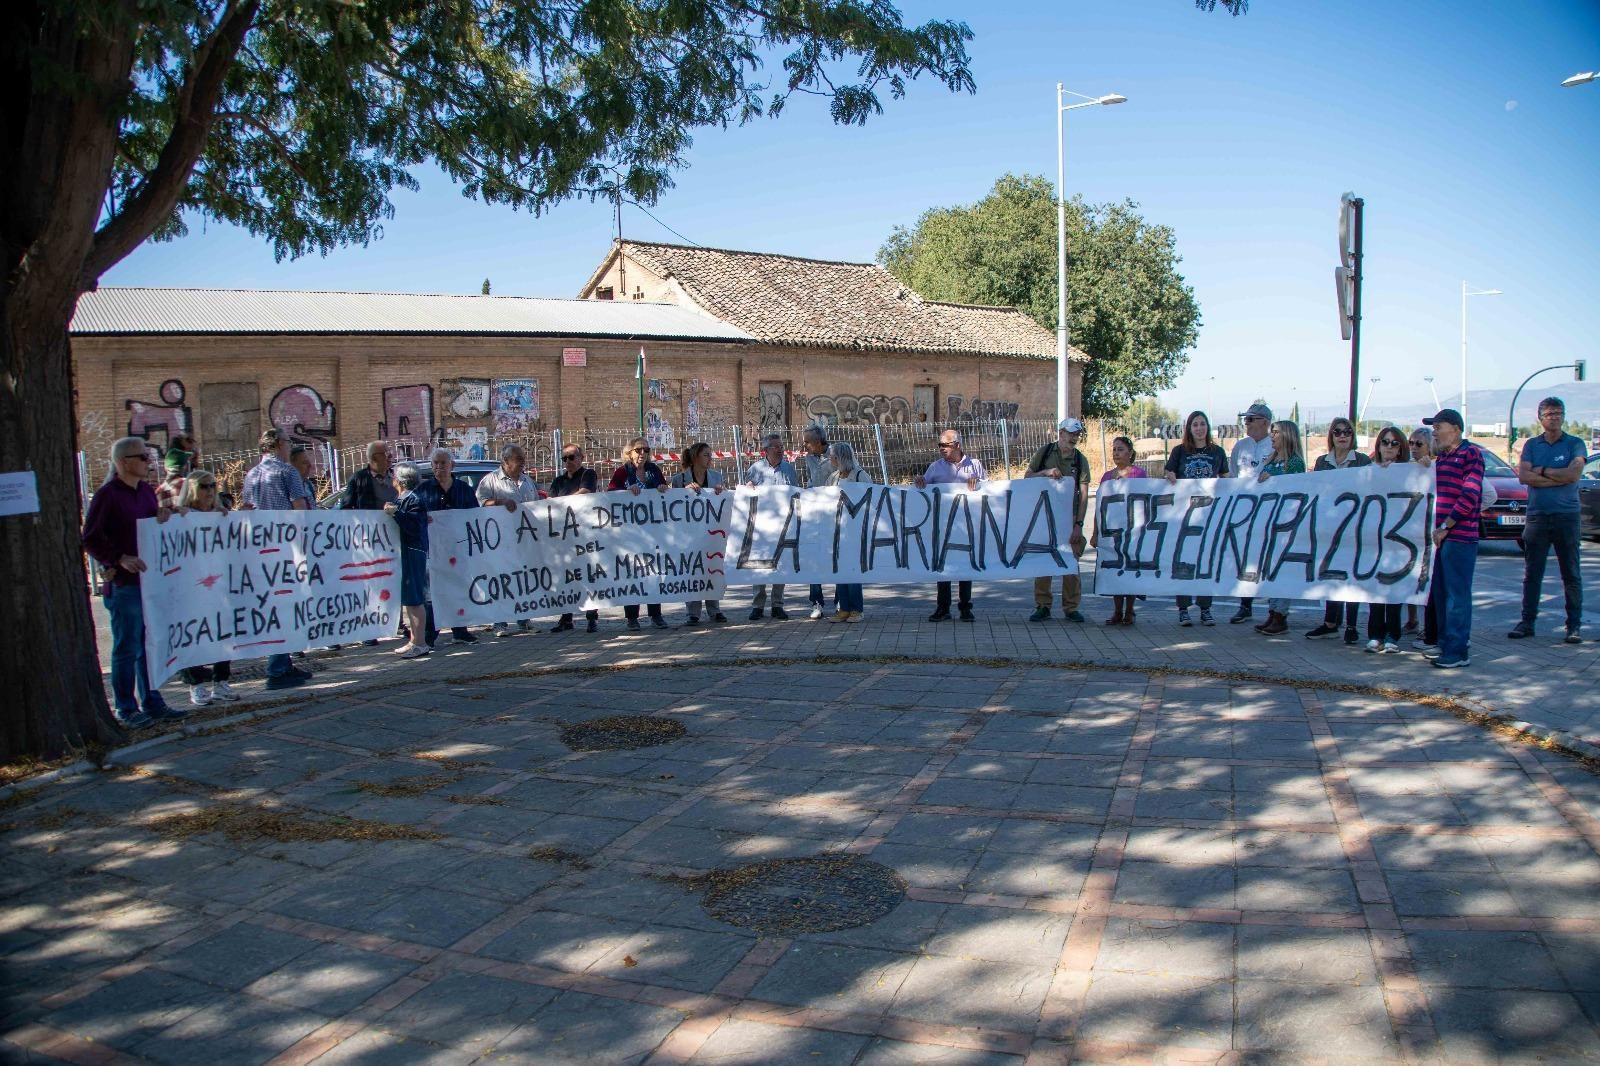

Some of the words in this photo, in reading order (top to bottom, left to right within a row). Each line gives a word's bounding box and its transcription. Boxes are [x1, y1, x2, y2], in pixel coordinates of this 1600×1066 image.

[160, 521, 297, 572] AYUNTAMIENTO
[465, 518, 501, 556] NO
[516, 511, 539, 544] A
[547, 505, 579, 540] LA
[575, 541, 605, 556] DEL
[736, 492, 801, 573] LA
[832, 487, 1068, 573] MARIANA
[1171, 493, 1319, 584] EUROPA
[229, 563, 254, 594] LA
[262, 560, 324, 587] VEGA
[565, 568, 582, 584] DE
[587, 563, 607, 583] LA
[614, 545, 705, 581] MARIANA
[256, 591, 269, 608] Y
[587, 582, 648, 601] VECINAL
[659, 579, 714, 595] ROSALEDA
[167, 606, 281, 657] ROSALEDA
[294, 587, 371, 631] NECESITAN
[308, 622, 335, 640] ESTE
[339, 606, 389, 636] ESPACIO
